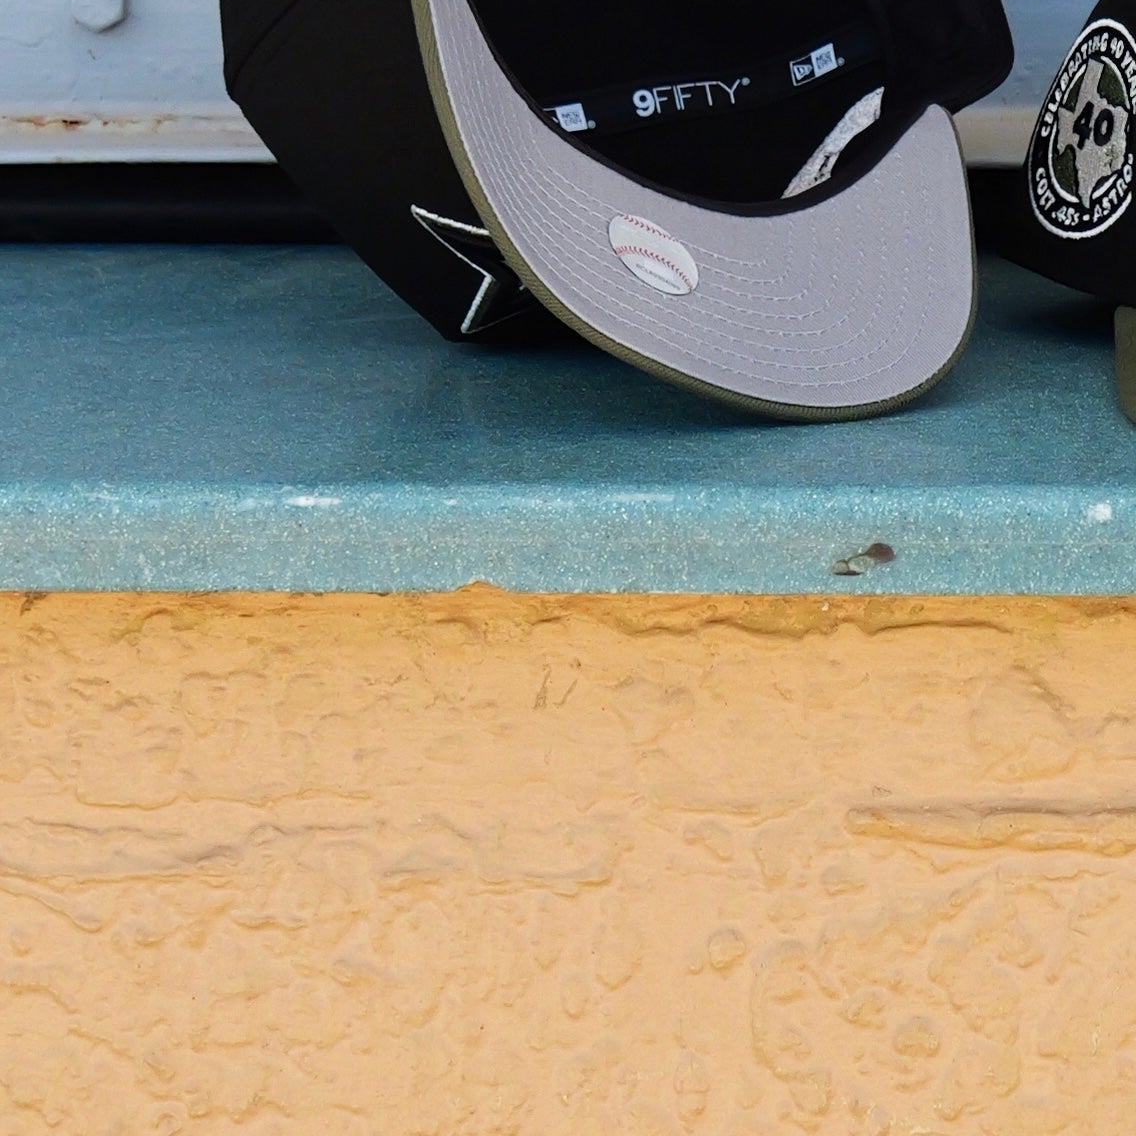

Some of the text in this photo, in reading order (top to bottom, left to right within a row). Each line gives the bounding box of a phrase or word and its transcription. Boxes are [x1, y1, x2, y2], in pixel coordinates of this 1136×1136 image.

[633, 79, 741, 117] 9FIFTY
[1041, 32, 1109, 137] CELEBRATING
[1110, 37, 1125, 59] 40
[1073, 100, 1114, 150] 40
